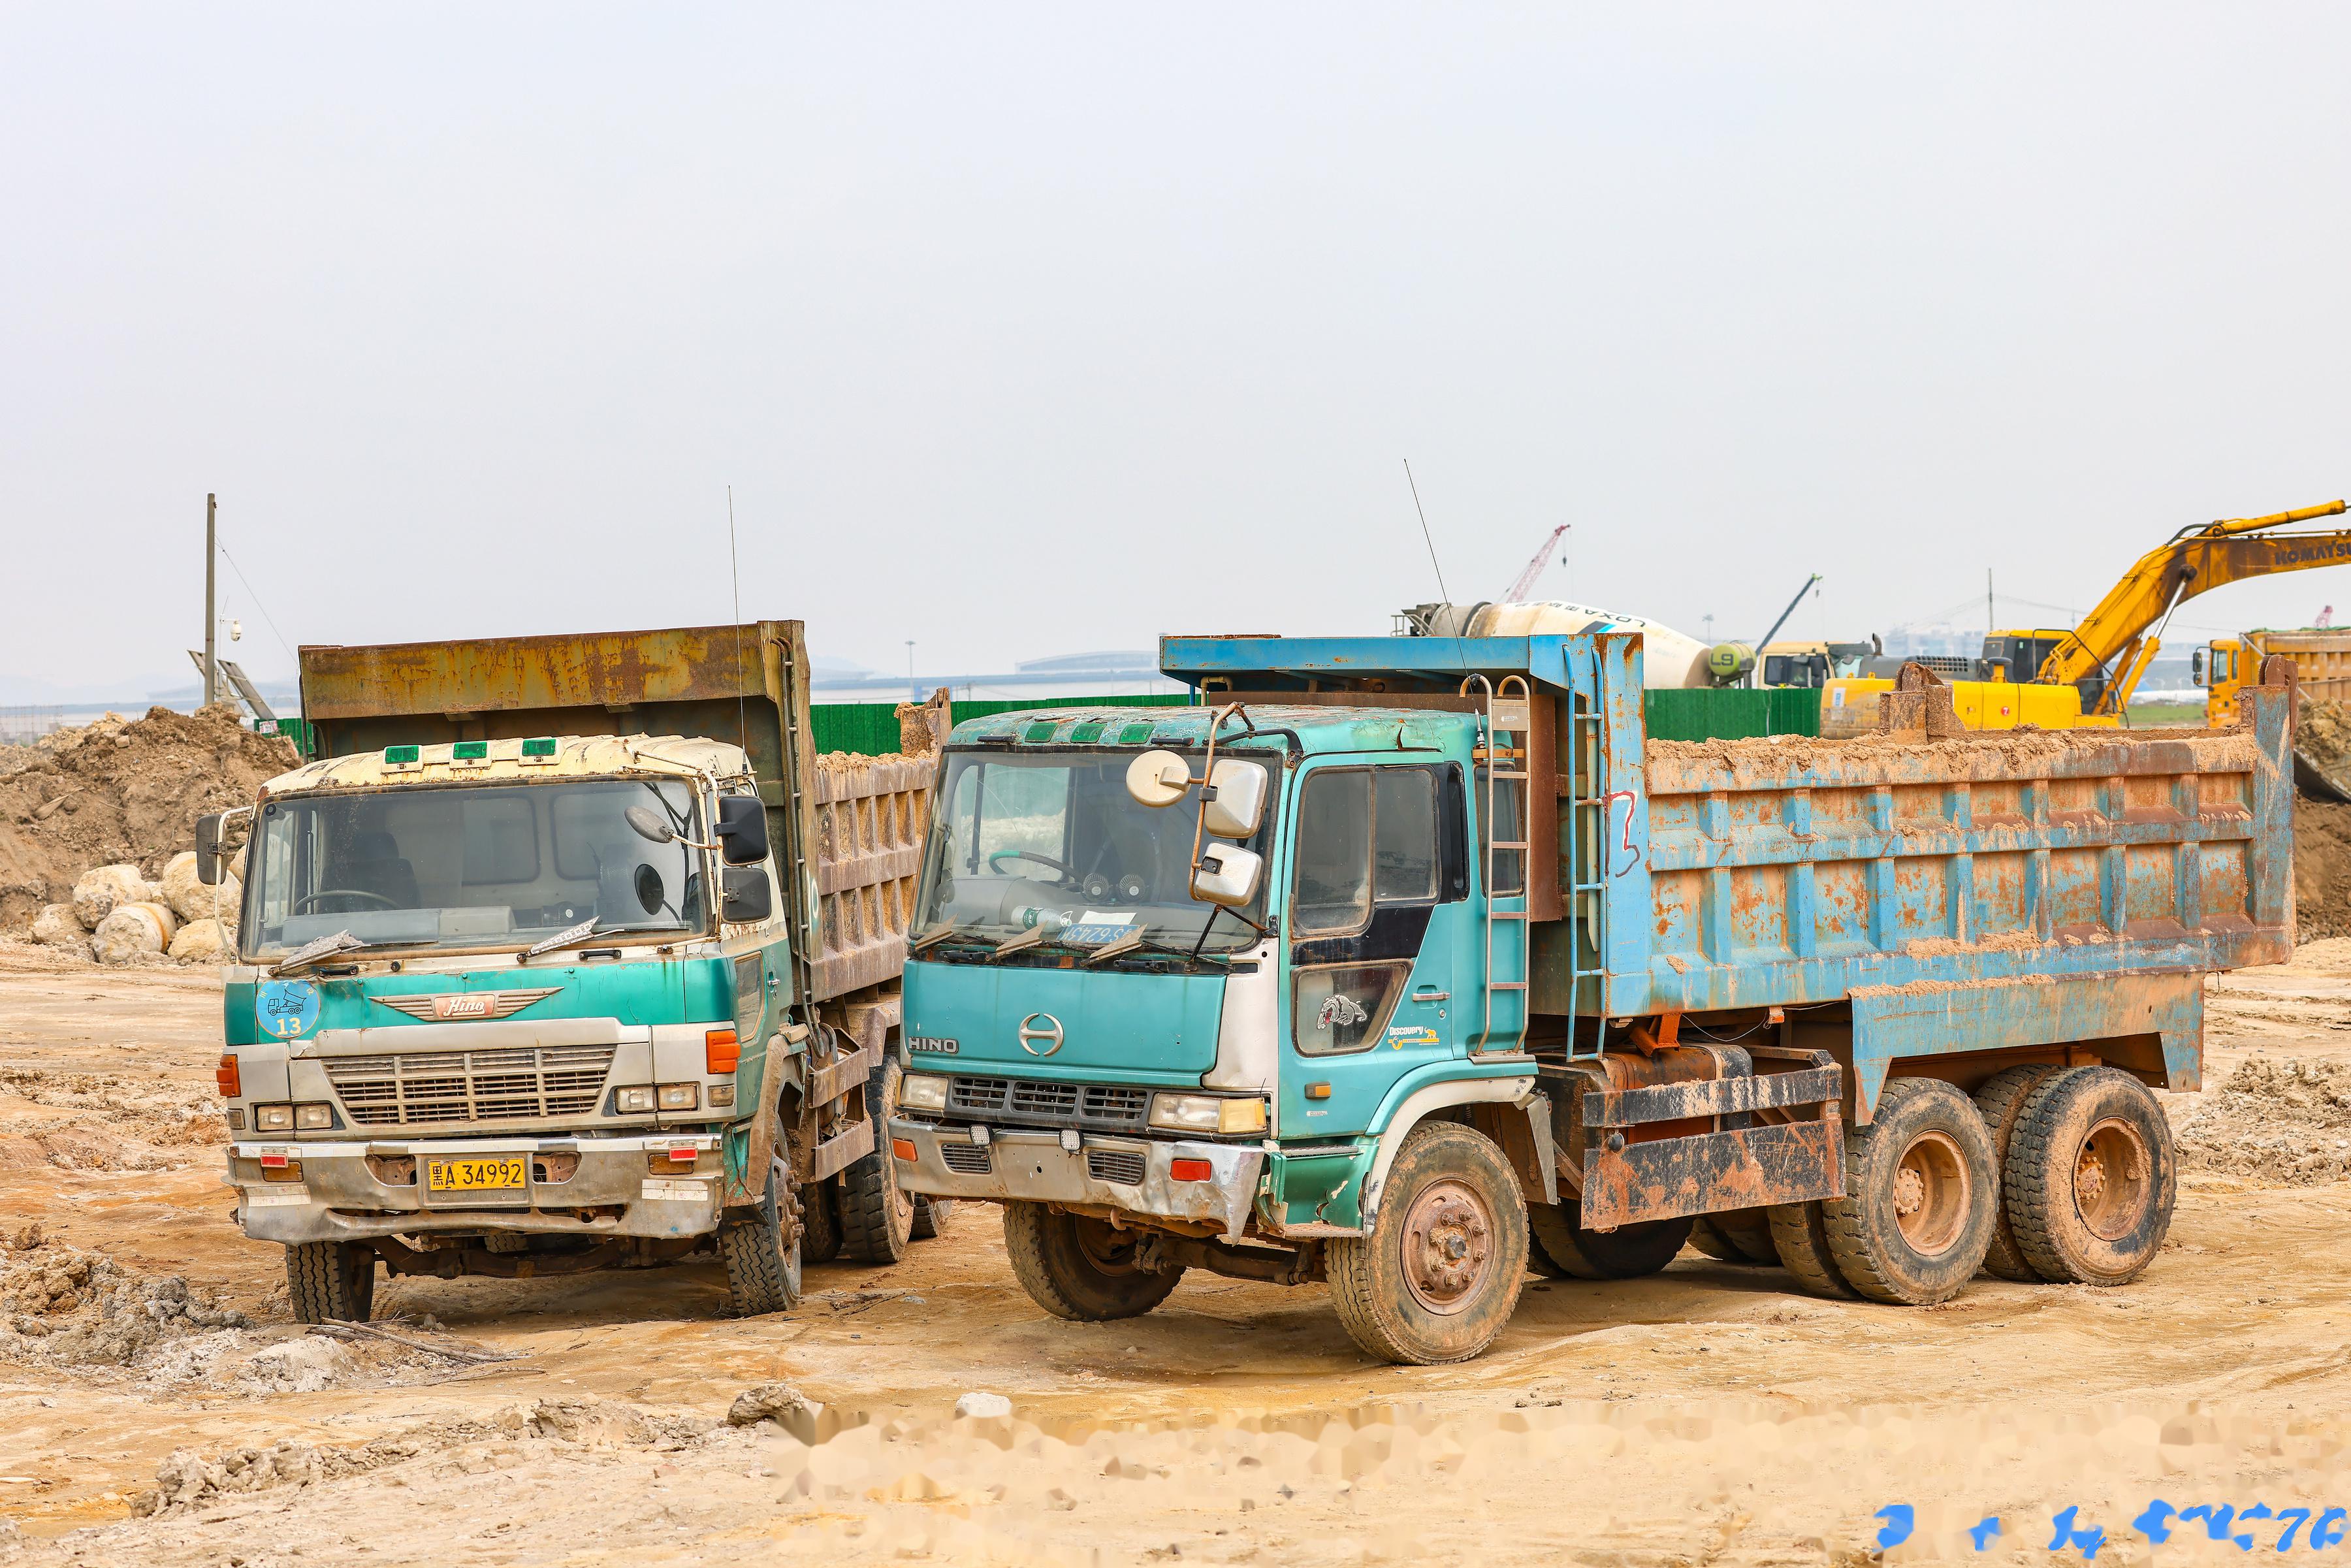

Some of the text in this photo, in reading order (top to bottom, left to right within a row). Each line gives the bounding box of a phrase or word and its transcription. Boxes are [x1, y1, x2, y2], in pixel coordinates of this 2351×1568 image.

[1710, 653, 1734, 666] L9
[443, 997, 485, 1016] Hino
[276, 1017, 301, 1035] 13
[908, 1036, 958, 1054] HINO
